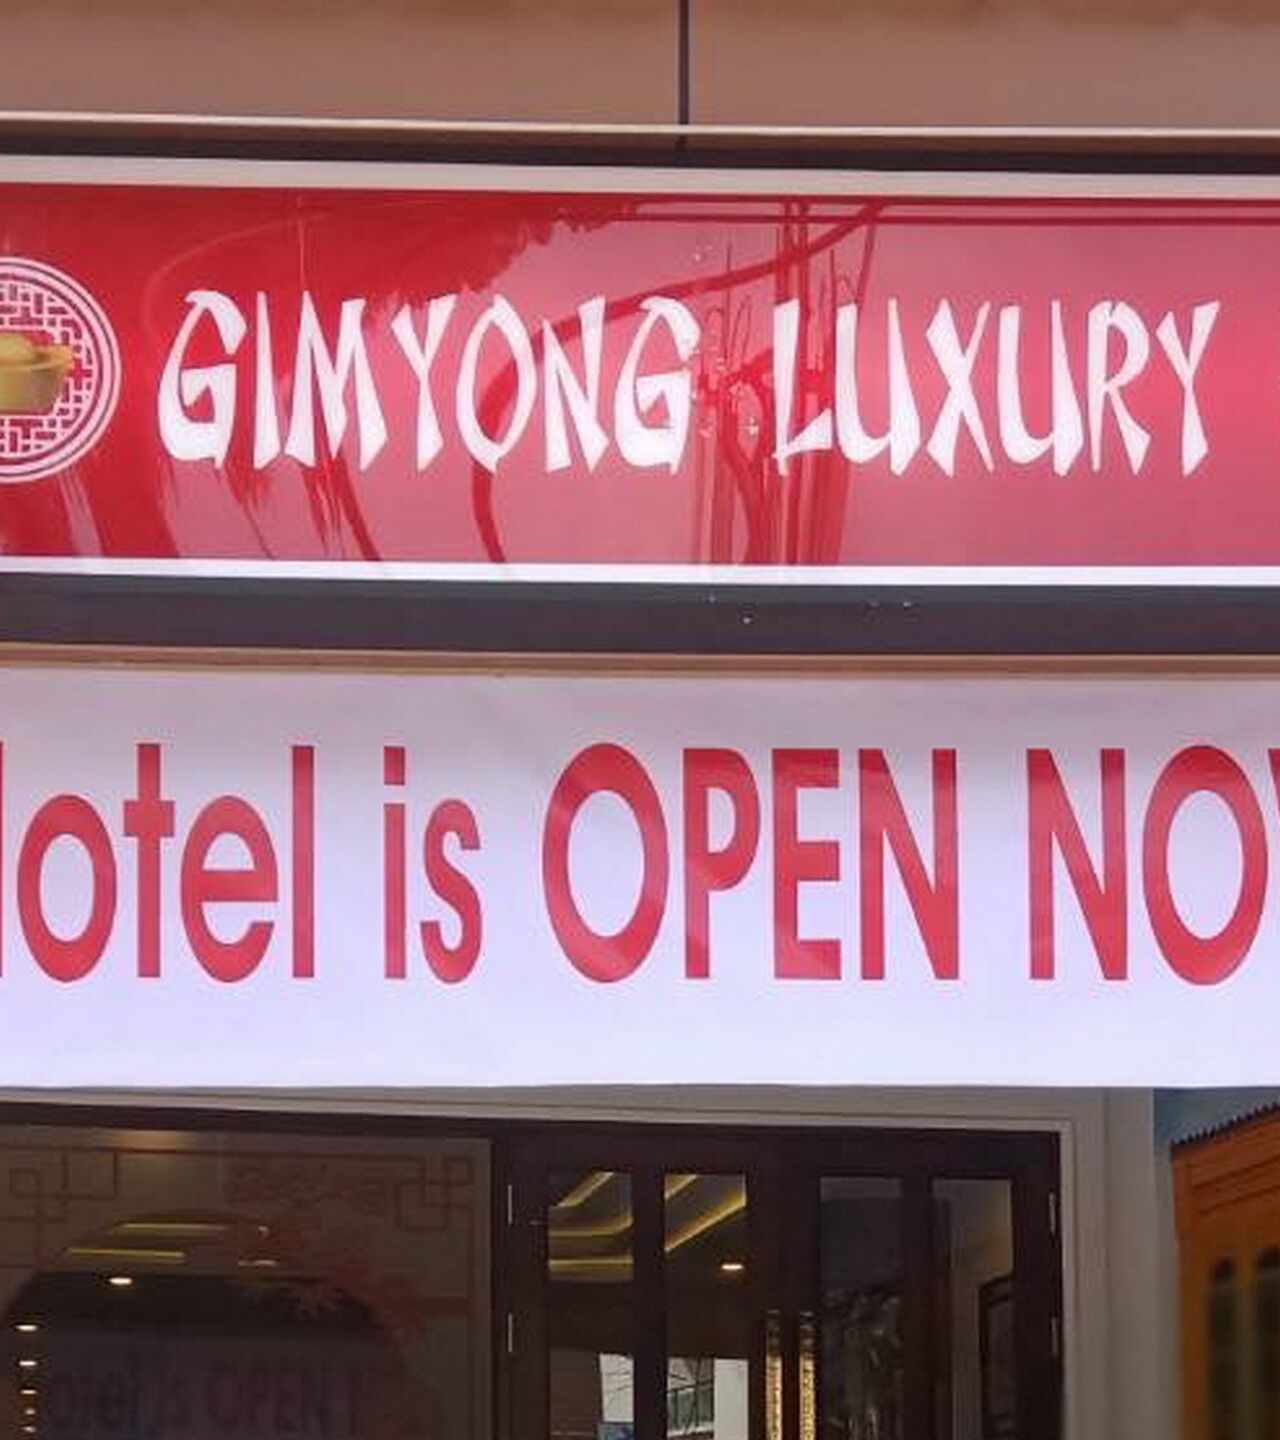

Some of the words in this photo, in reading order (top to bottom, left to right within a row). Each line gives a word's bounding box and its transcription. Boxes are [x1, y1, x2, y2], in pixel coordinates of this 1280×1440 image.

[157, 290, 701, 476] GIMYONG
[771, 297, 1221, 478] LUXURY
[384, 745, 482, 984] is
[542, 742, 960, 985] OPEN
